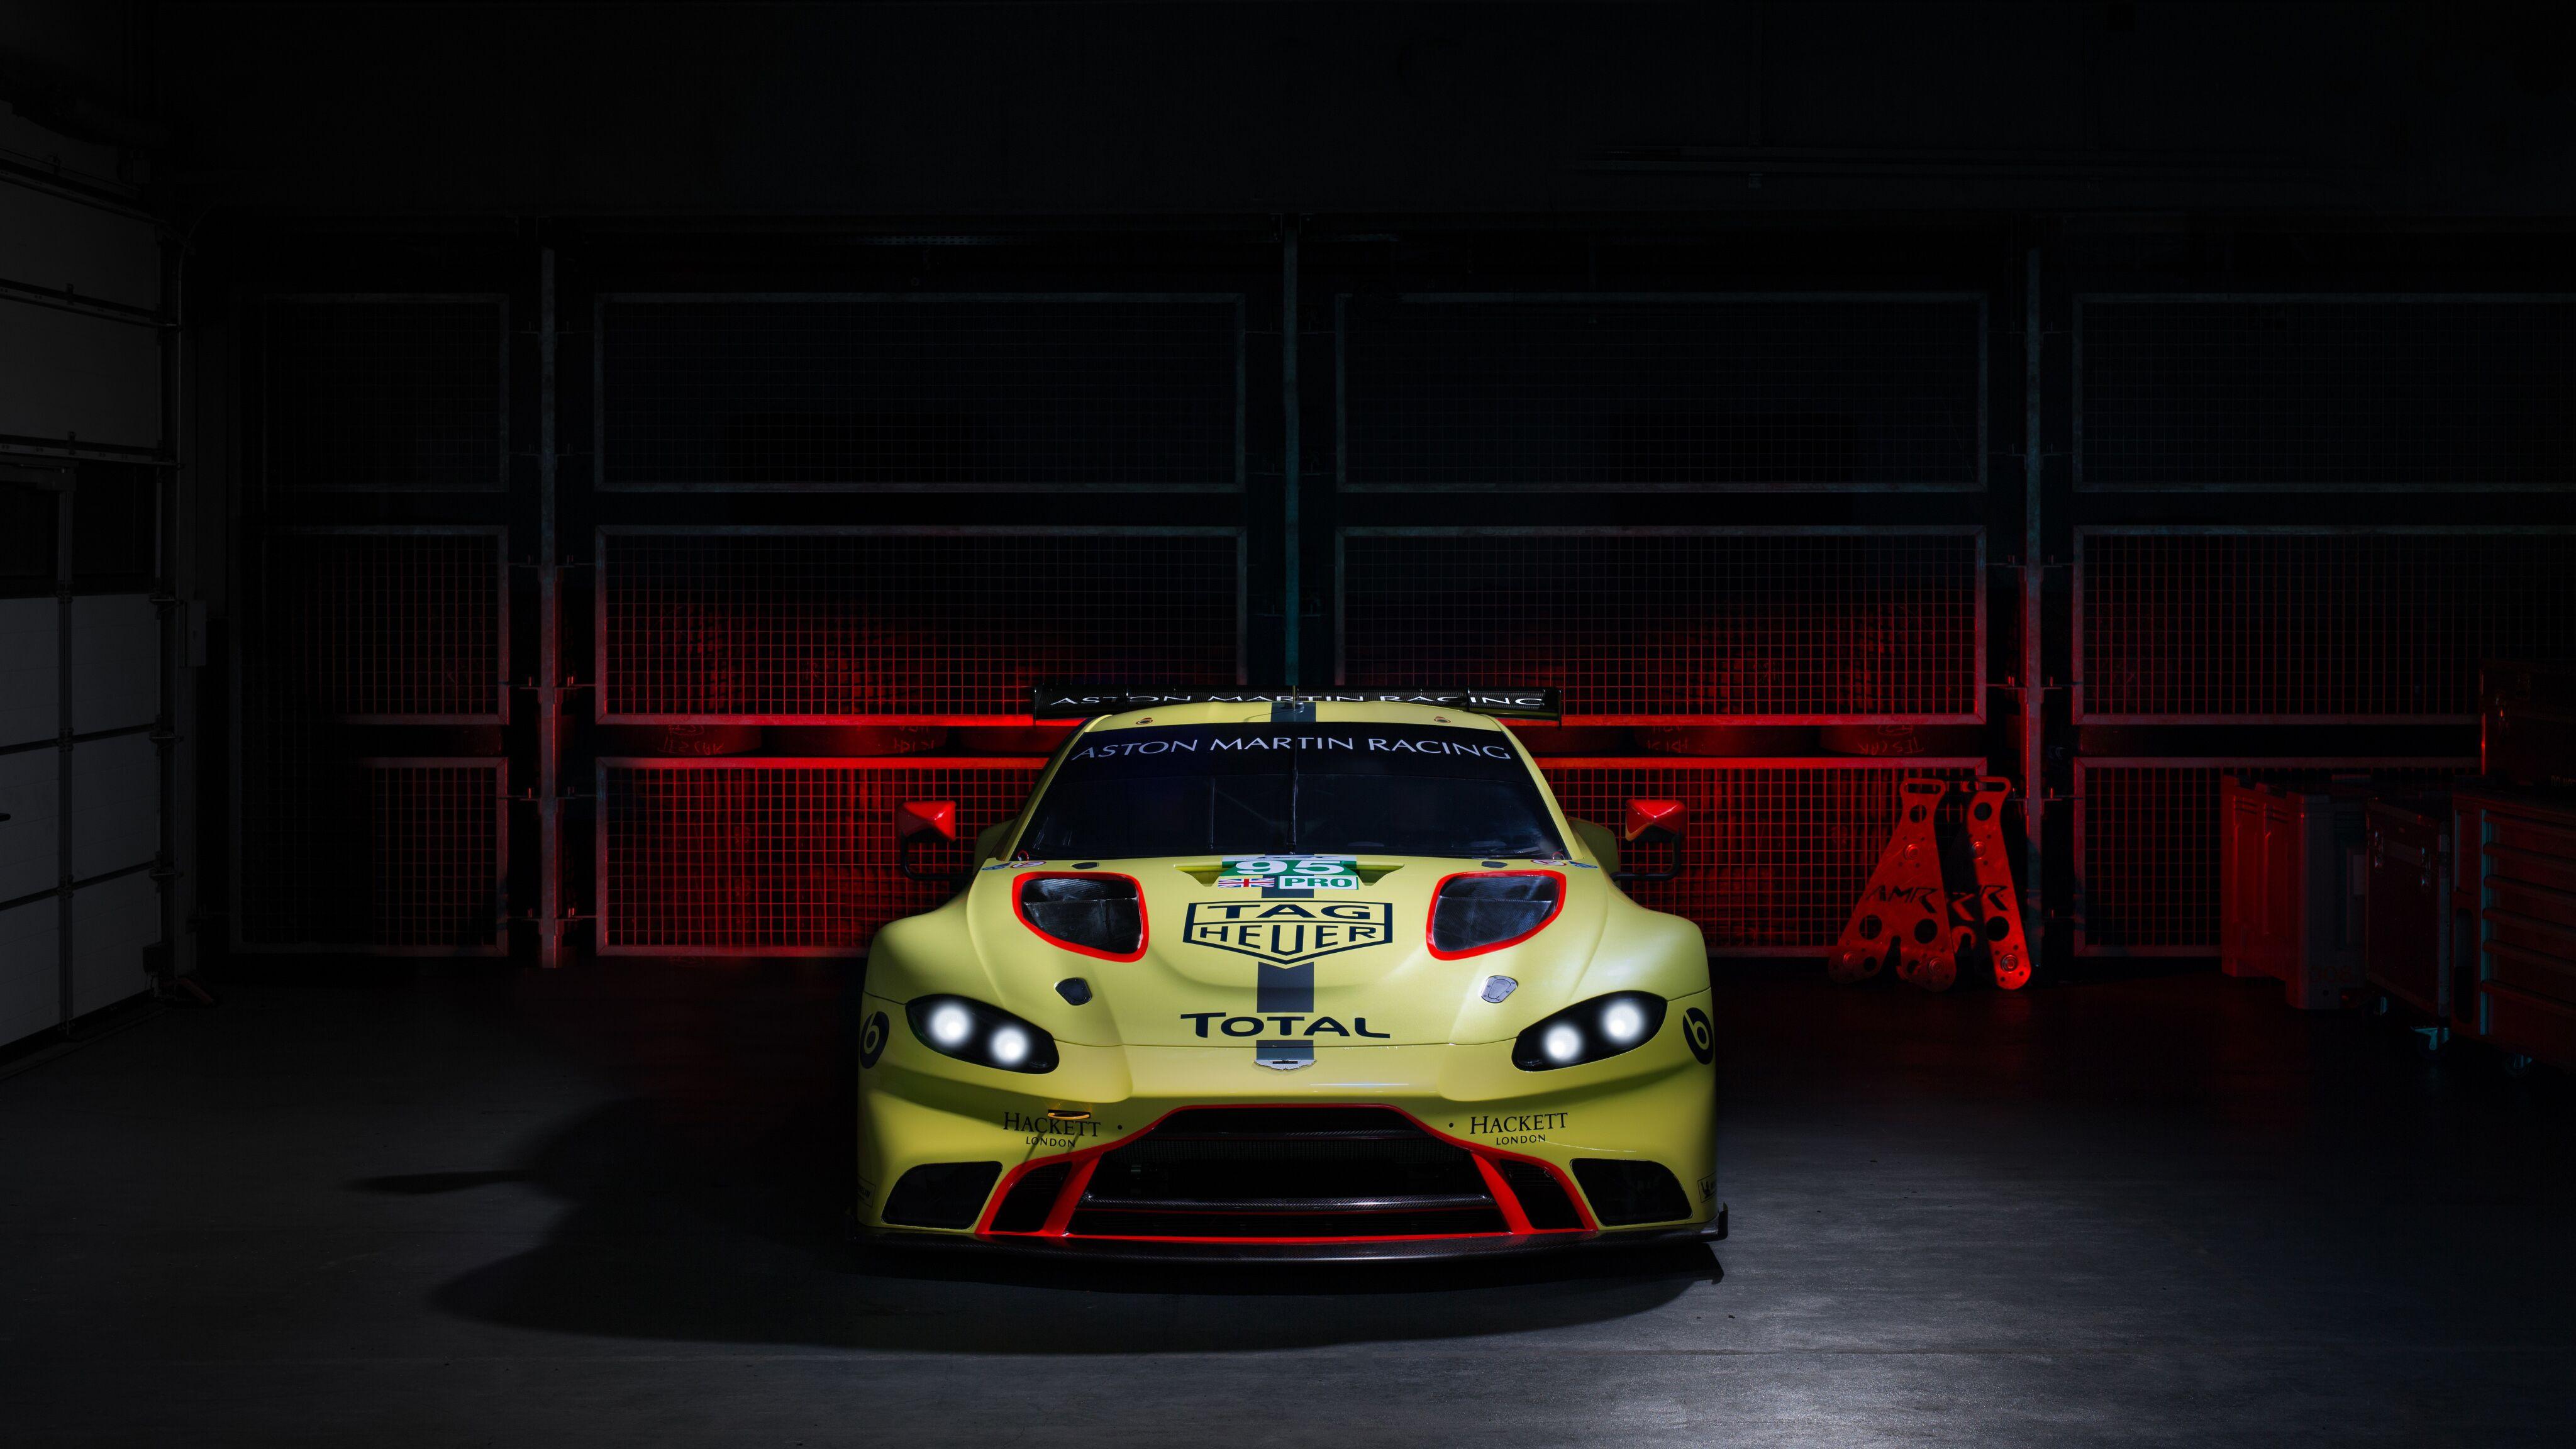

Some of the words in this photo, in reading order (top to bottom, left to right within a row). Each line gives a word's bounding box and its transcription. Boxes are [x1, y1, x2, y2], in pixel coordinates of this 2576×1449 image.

[1050, 696, 1191, 705] ASTON
[1380, 696, 1545, 706] RACING
[1071, 739, 1197, 760] ASTON
[1210, 737, 1353, 751] MARTIN
[1368, 738, 1511, 759] RACING
[1235, 860, 1345, 875] 95
[1284, 877, 1353, 887] PRO
[1866, 885, 1939, 914] AMR
[1207, 904, 1371, 919] TAG
[1199, 924, 1377, 956] HEUER
[1180, 1012, 1391, 1038] TOTAL
[1002, 1111, 1101, 1137] HACKETT
[1470, 1112, 1568, 1135] HACKETT
[1026, 1136, 1075, 1148] LONDON
[1496, 1134, 1546, 1145] LONDON
